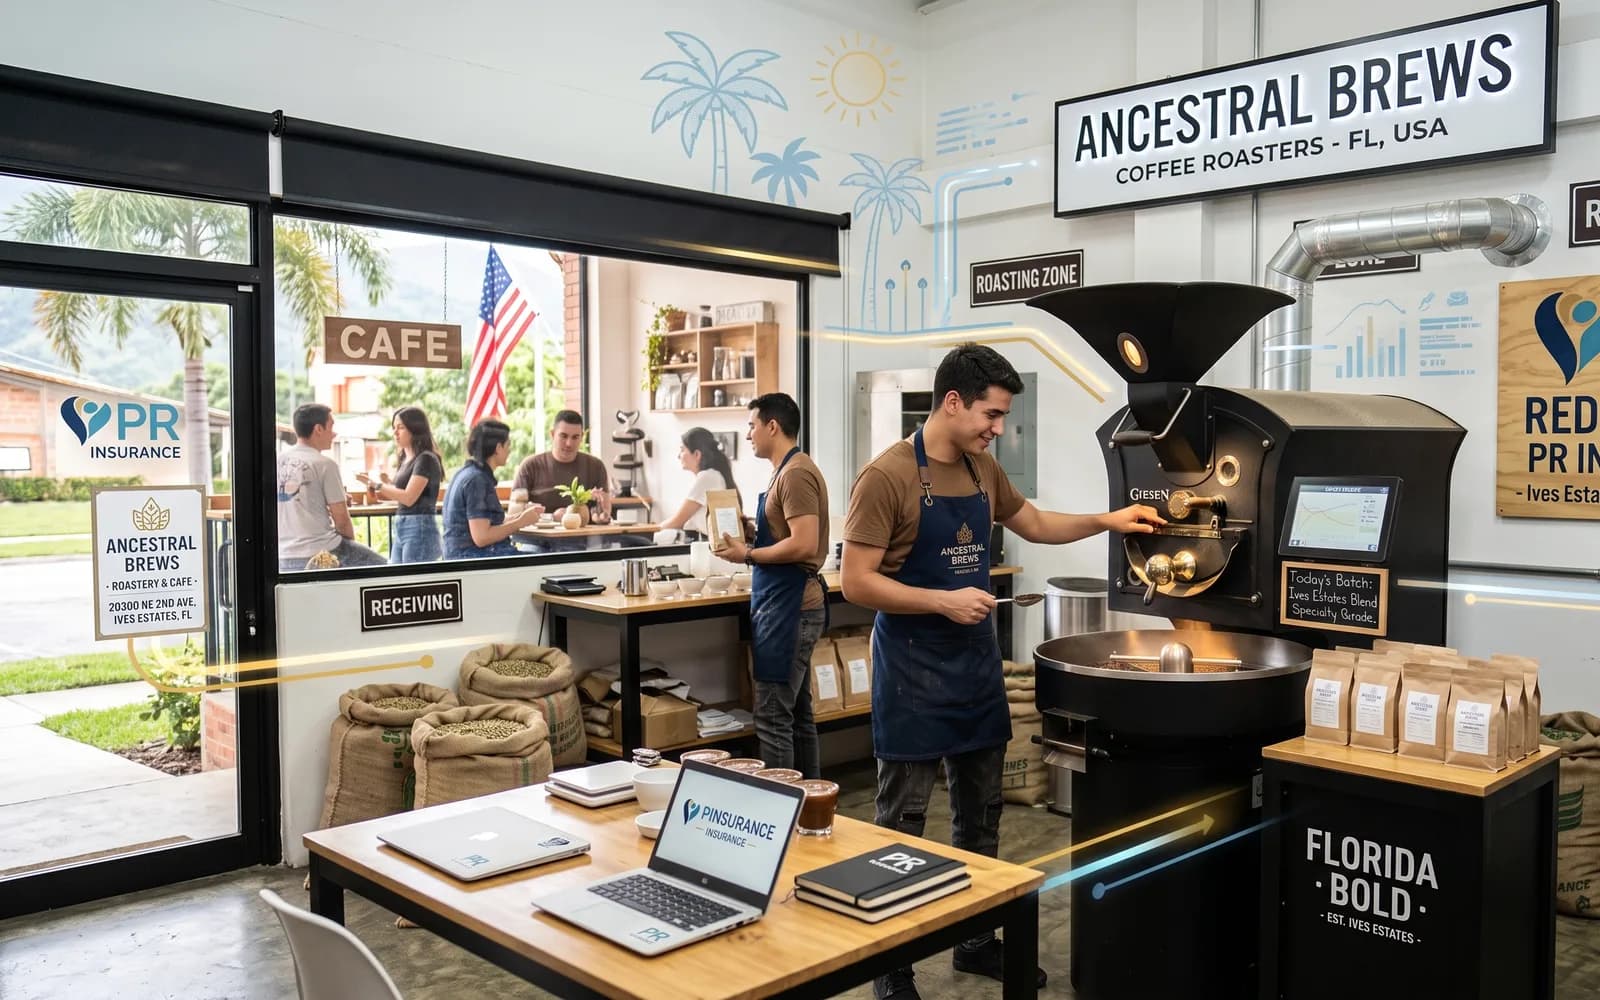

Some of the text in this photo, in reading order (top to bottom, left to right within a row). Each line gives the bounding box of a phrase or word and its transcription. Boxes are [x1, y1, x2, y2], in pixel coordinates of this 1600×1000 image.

[1075, 33, 1513, 162] ANCESTRAL BREWS
[1116, 157, 1195, 184] COFFEE
[1203, 137, 1324, 172] ROASTERS
[1349, 129, 1384, 150] FL,
[1394, 117, 1449, 142] USA
[976, 264, 1077, 294] ROASTING ZONE
[340, 325, 448, 362] CAFE
[117, 402, 179, 441] PR
[1525, 395, 1598, 435] RED
[90, 445, 181, 459] INSURANCE
[1528, 442, 1568, 474] PR
[1130, 488, 1170, 502] GIESEN
[1527, 484, 1560, 502] Ives
[106, 535, 197, 554] ANCESTRAL
[940, 543, 985, 556] ANCESTRAL
[125, 555, 180, 573] BREWS
[952, 554, 979, 565] BREWS
[112, 577, 193, 591] ROASTERY & CAFE
[1290, 570, 1373, 595] Today's Batch:
[109, 601, 140, 612] 20300
[141, 600, 154, 610] NE
[156, 599, 174, 609] 2ND
[371, 593, 453, 617] RECEIVING
[1289, 587, 1378, 608] Ives Estates Blend
[114, 610, 192, 625] IVES ESTATES, FL
[1292, 603, 1337, 624] Specialty
[701, 806, 776, 840] PINSURANCE
[705, 828, 747, 848] INSURANCE
[878, 852, 927, 871] PR
[1306, 827, 1439, 890] FLORIDA
[1330, 872, 1411, 921] BOLD
[1327, 912, 1414, 944] EST. IVES ESTATES
